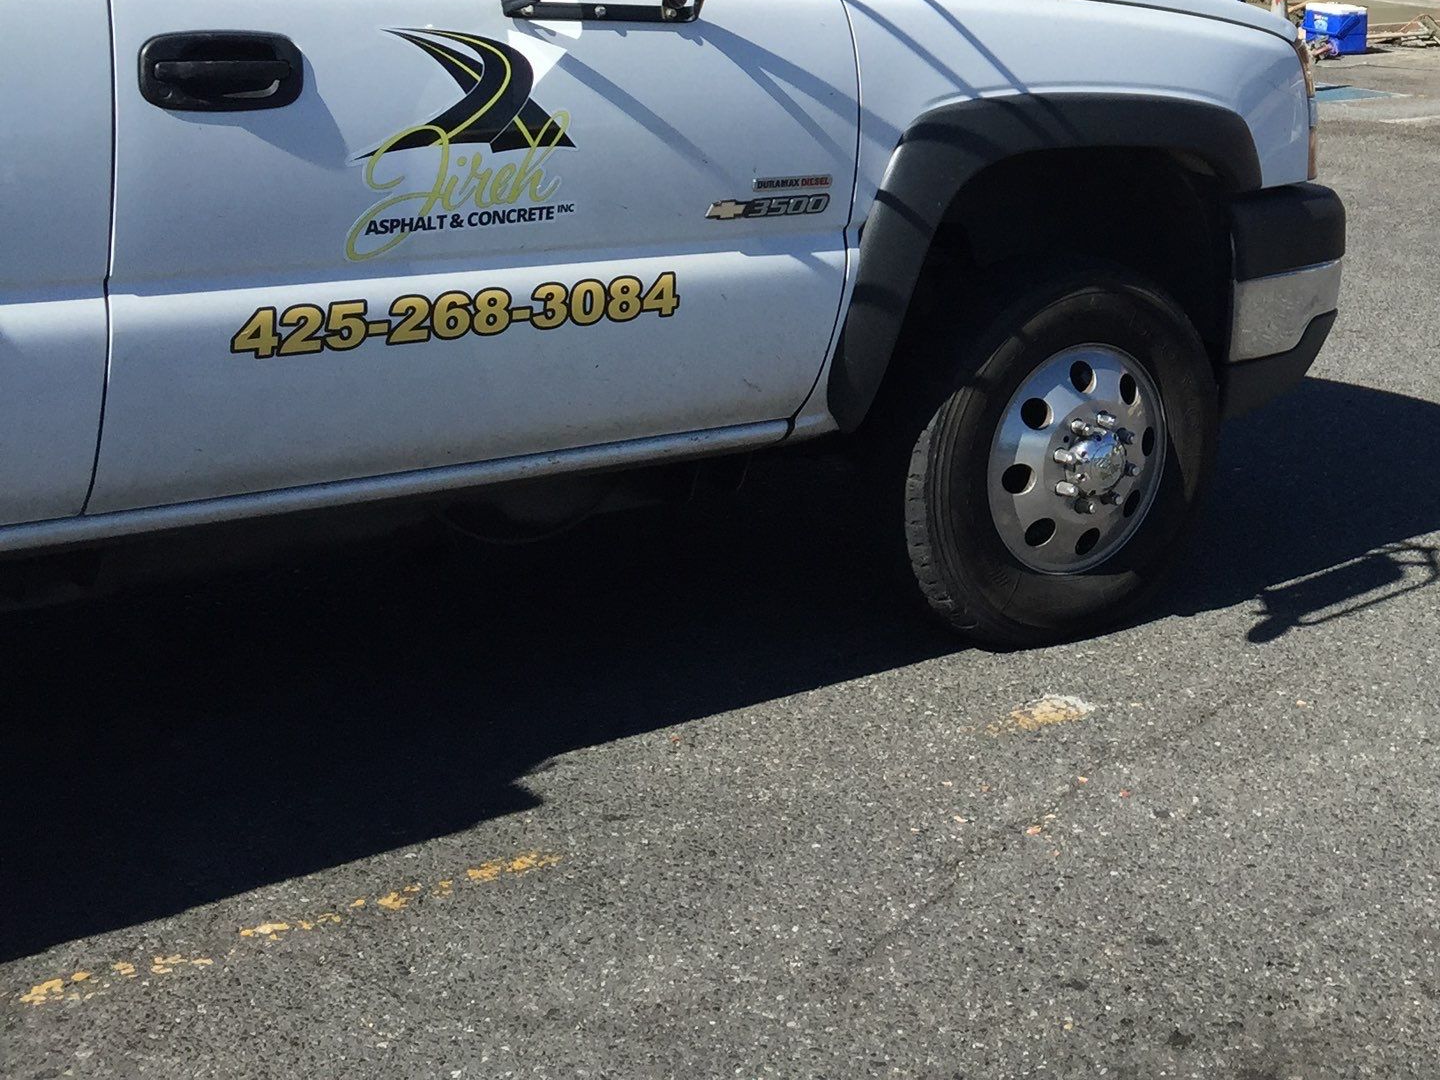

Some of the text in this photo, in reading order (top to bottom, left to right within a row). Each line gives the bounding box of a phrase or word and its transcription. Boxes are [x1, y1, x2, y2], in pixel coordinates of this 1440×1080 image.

[757, 176, 830, 189] DURAMAX DIESEL
[746, 193, 830, 218] 3500
[364, 204, 575, 236] ASPHALT & CONCRETE INC
[231, 272, 680, 358] 425-268-3084
